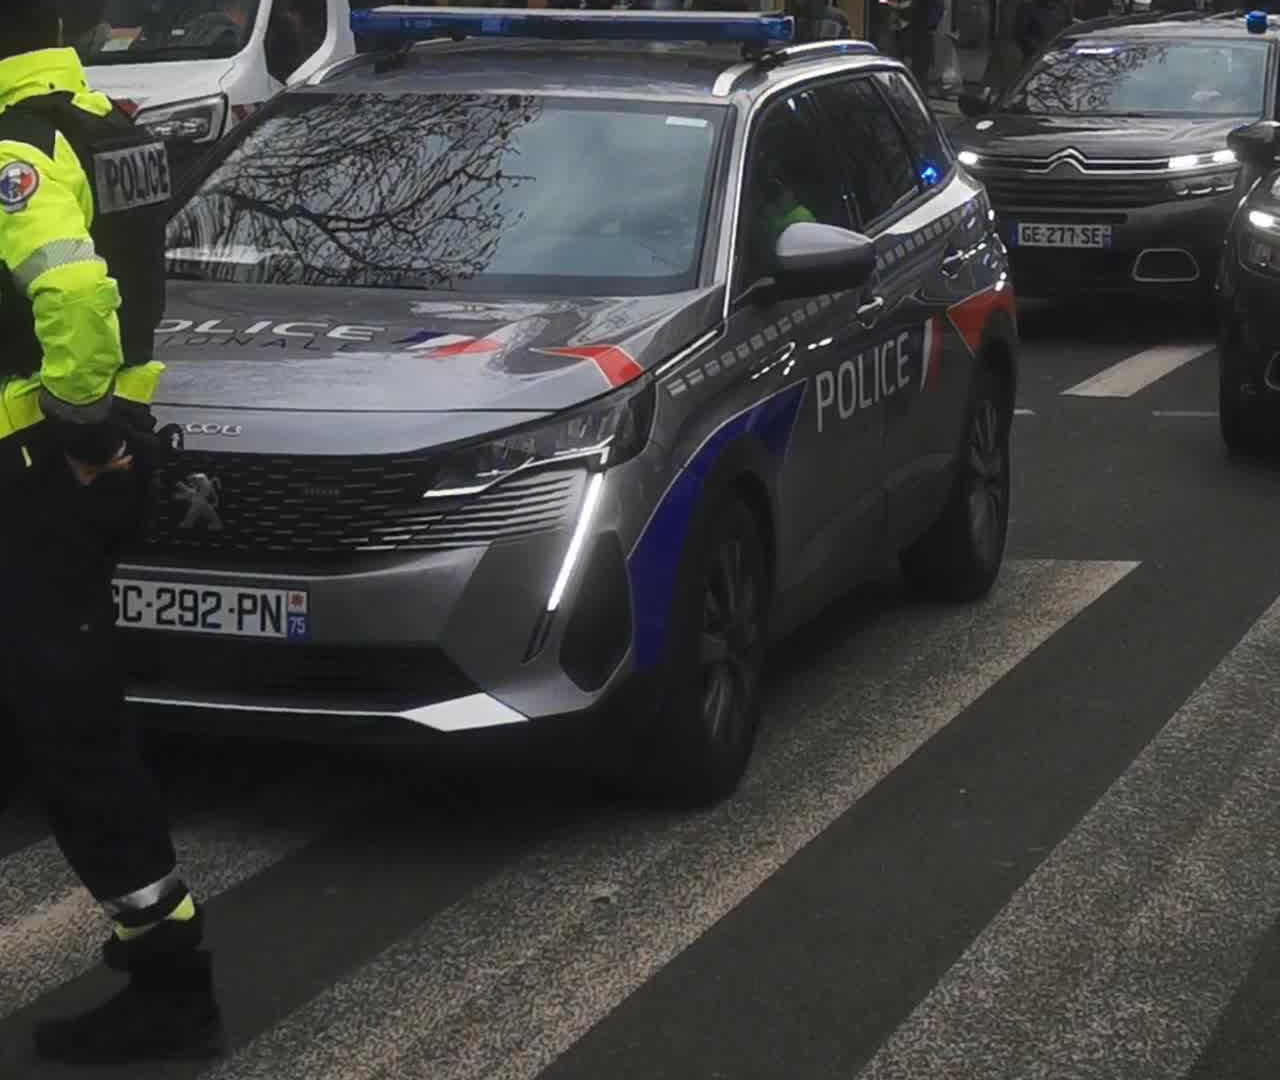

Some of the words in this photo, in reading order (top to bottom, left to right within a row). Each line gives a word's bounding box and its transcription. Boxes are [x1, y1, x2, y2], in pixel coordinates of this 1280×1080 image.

[104, 148, 168, 203] POLICE
[154, 319, 384, 341] OLICE
[816, 331, 910, 432] POLICE
